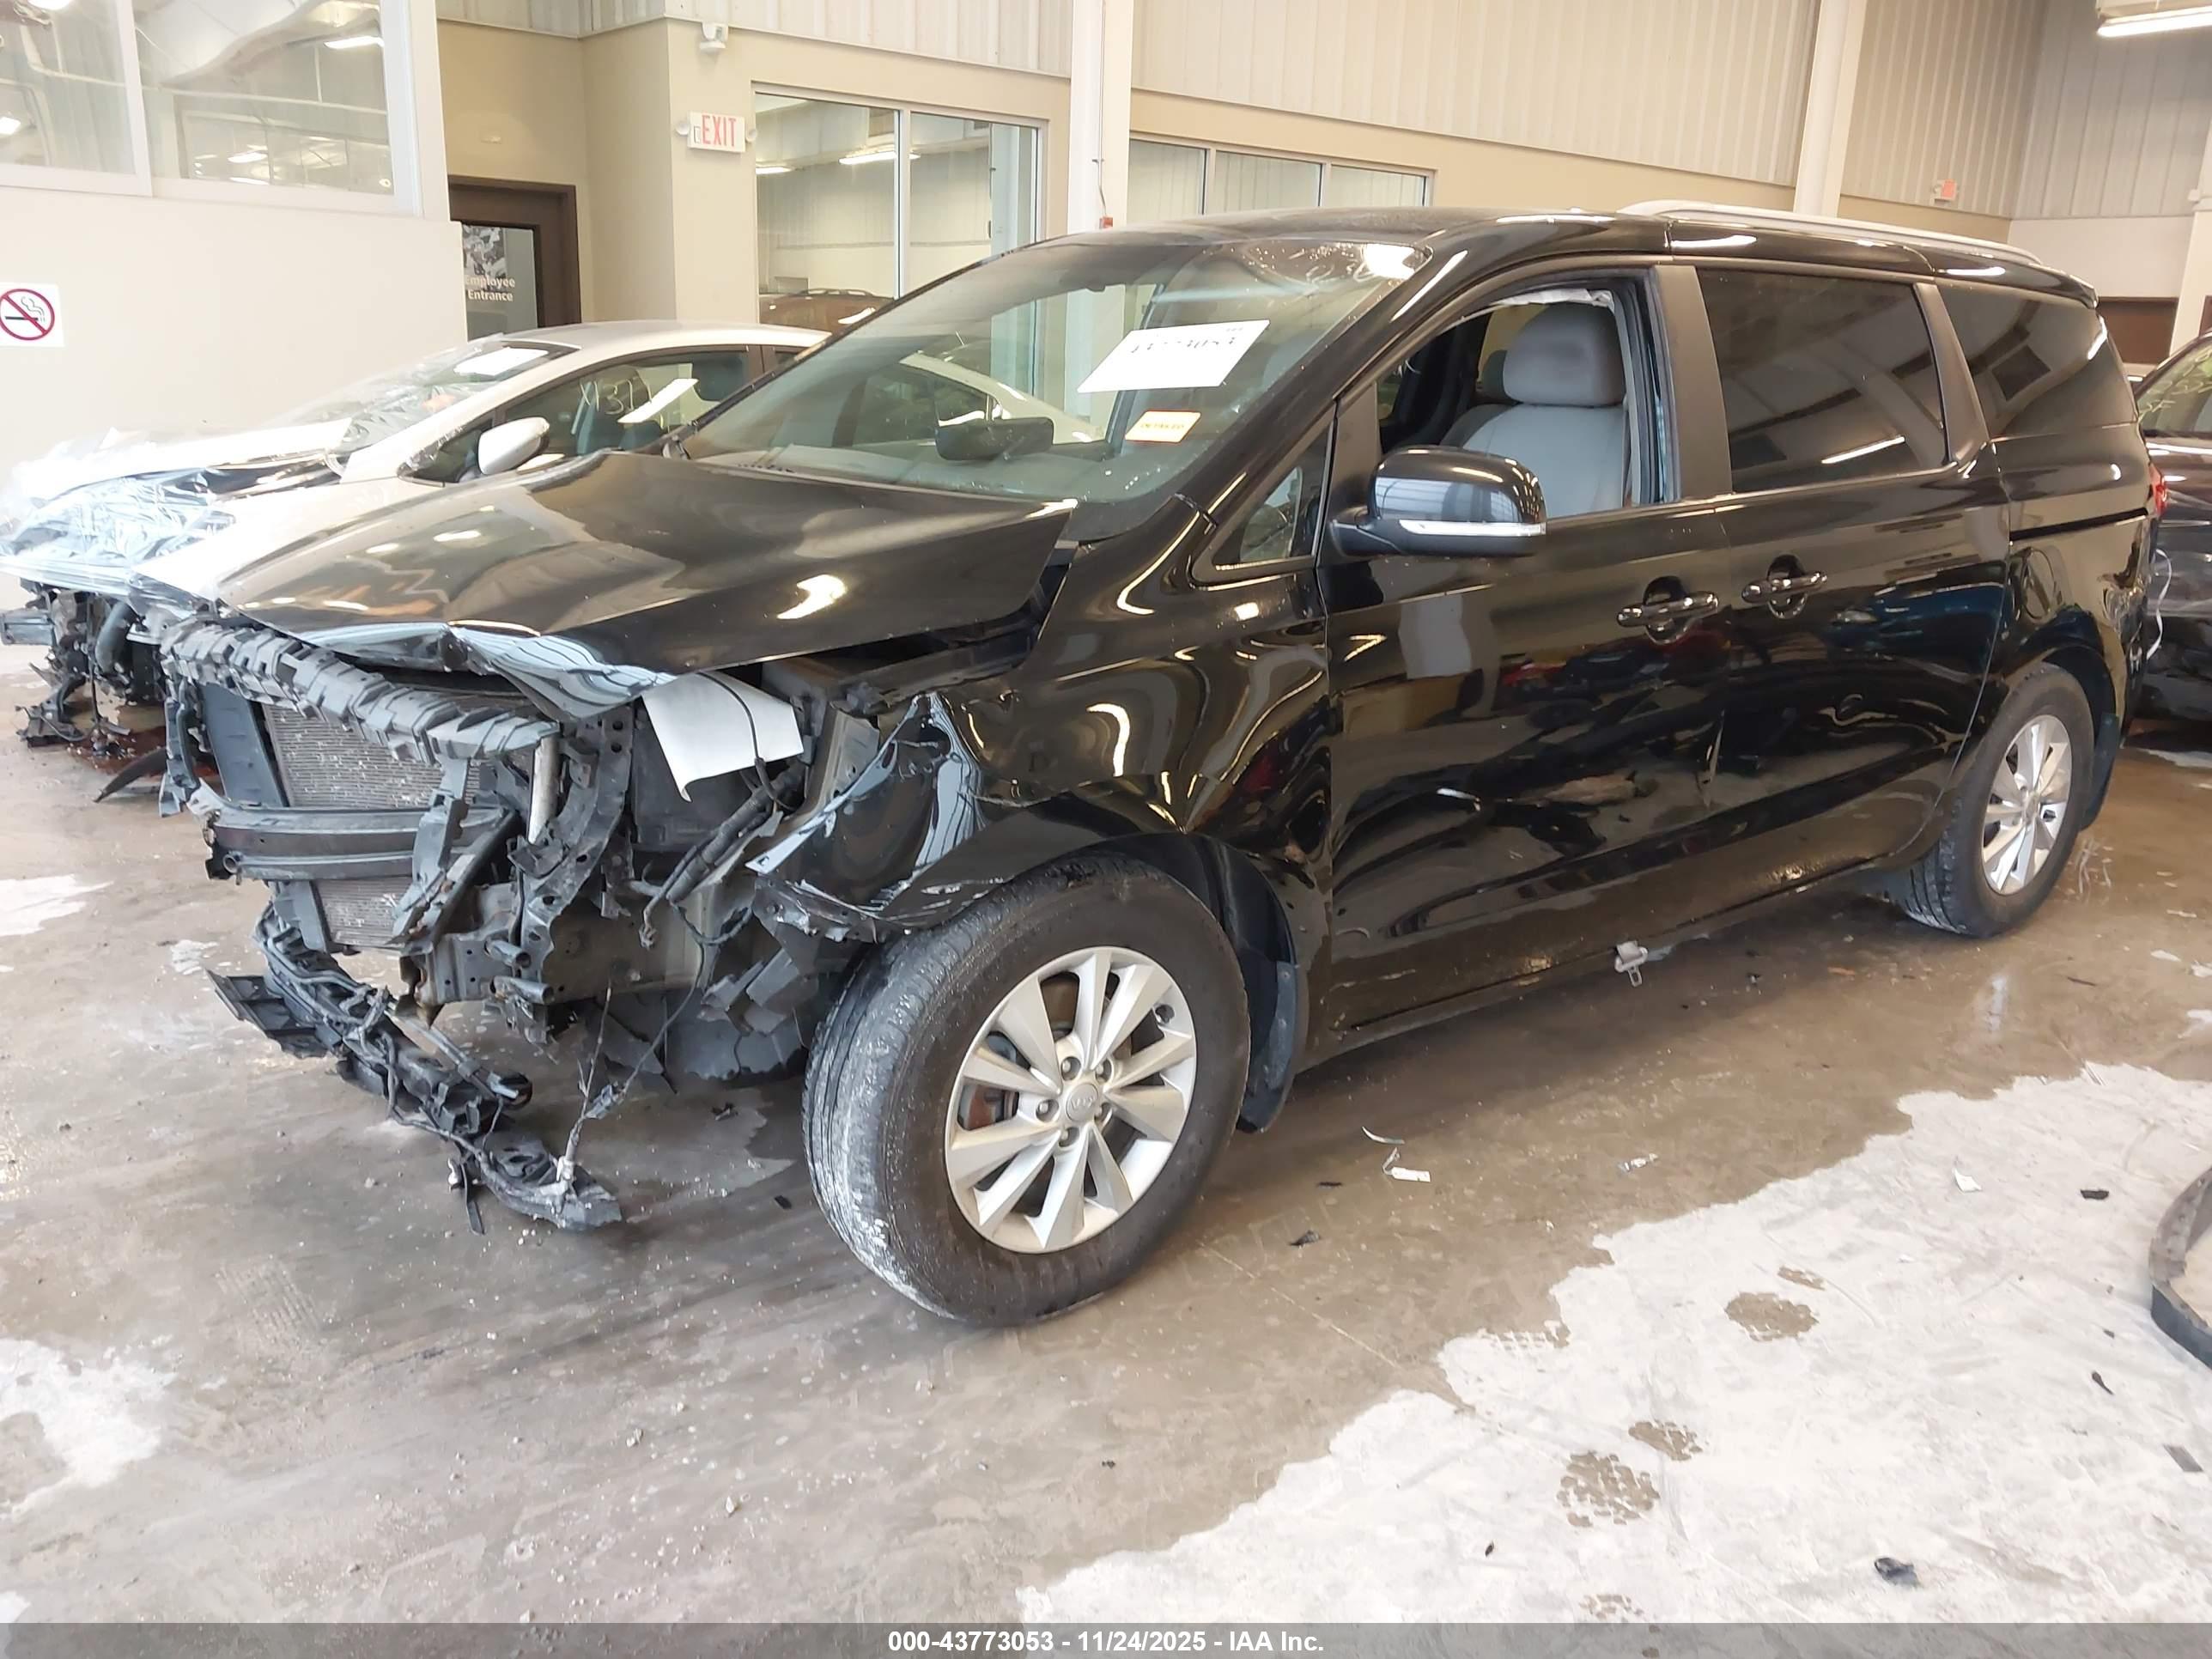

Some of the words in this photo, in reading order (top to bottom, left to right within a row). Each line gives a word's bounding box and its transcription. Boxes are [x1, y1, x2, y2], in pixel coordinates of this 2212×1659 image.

[702, 113, 737, 148] EXIT
[465, 275, 516, 290] Employee
[467, 289, 514, 301] Entrance
